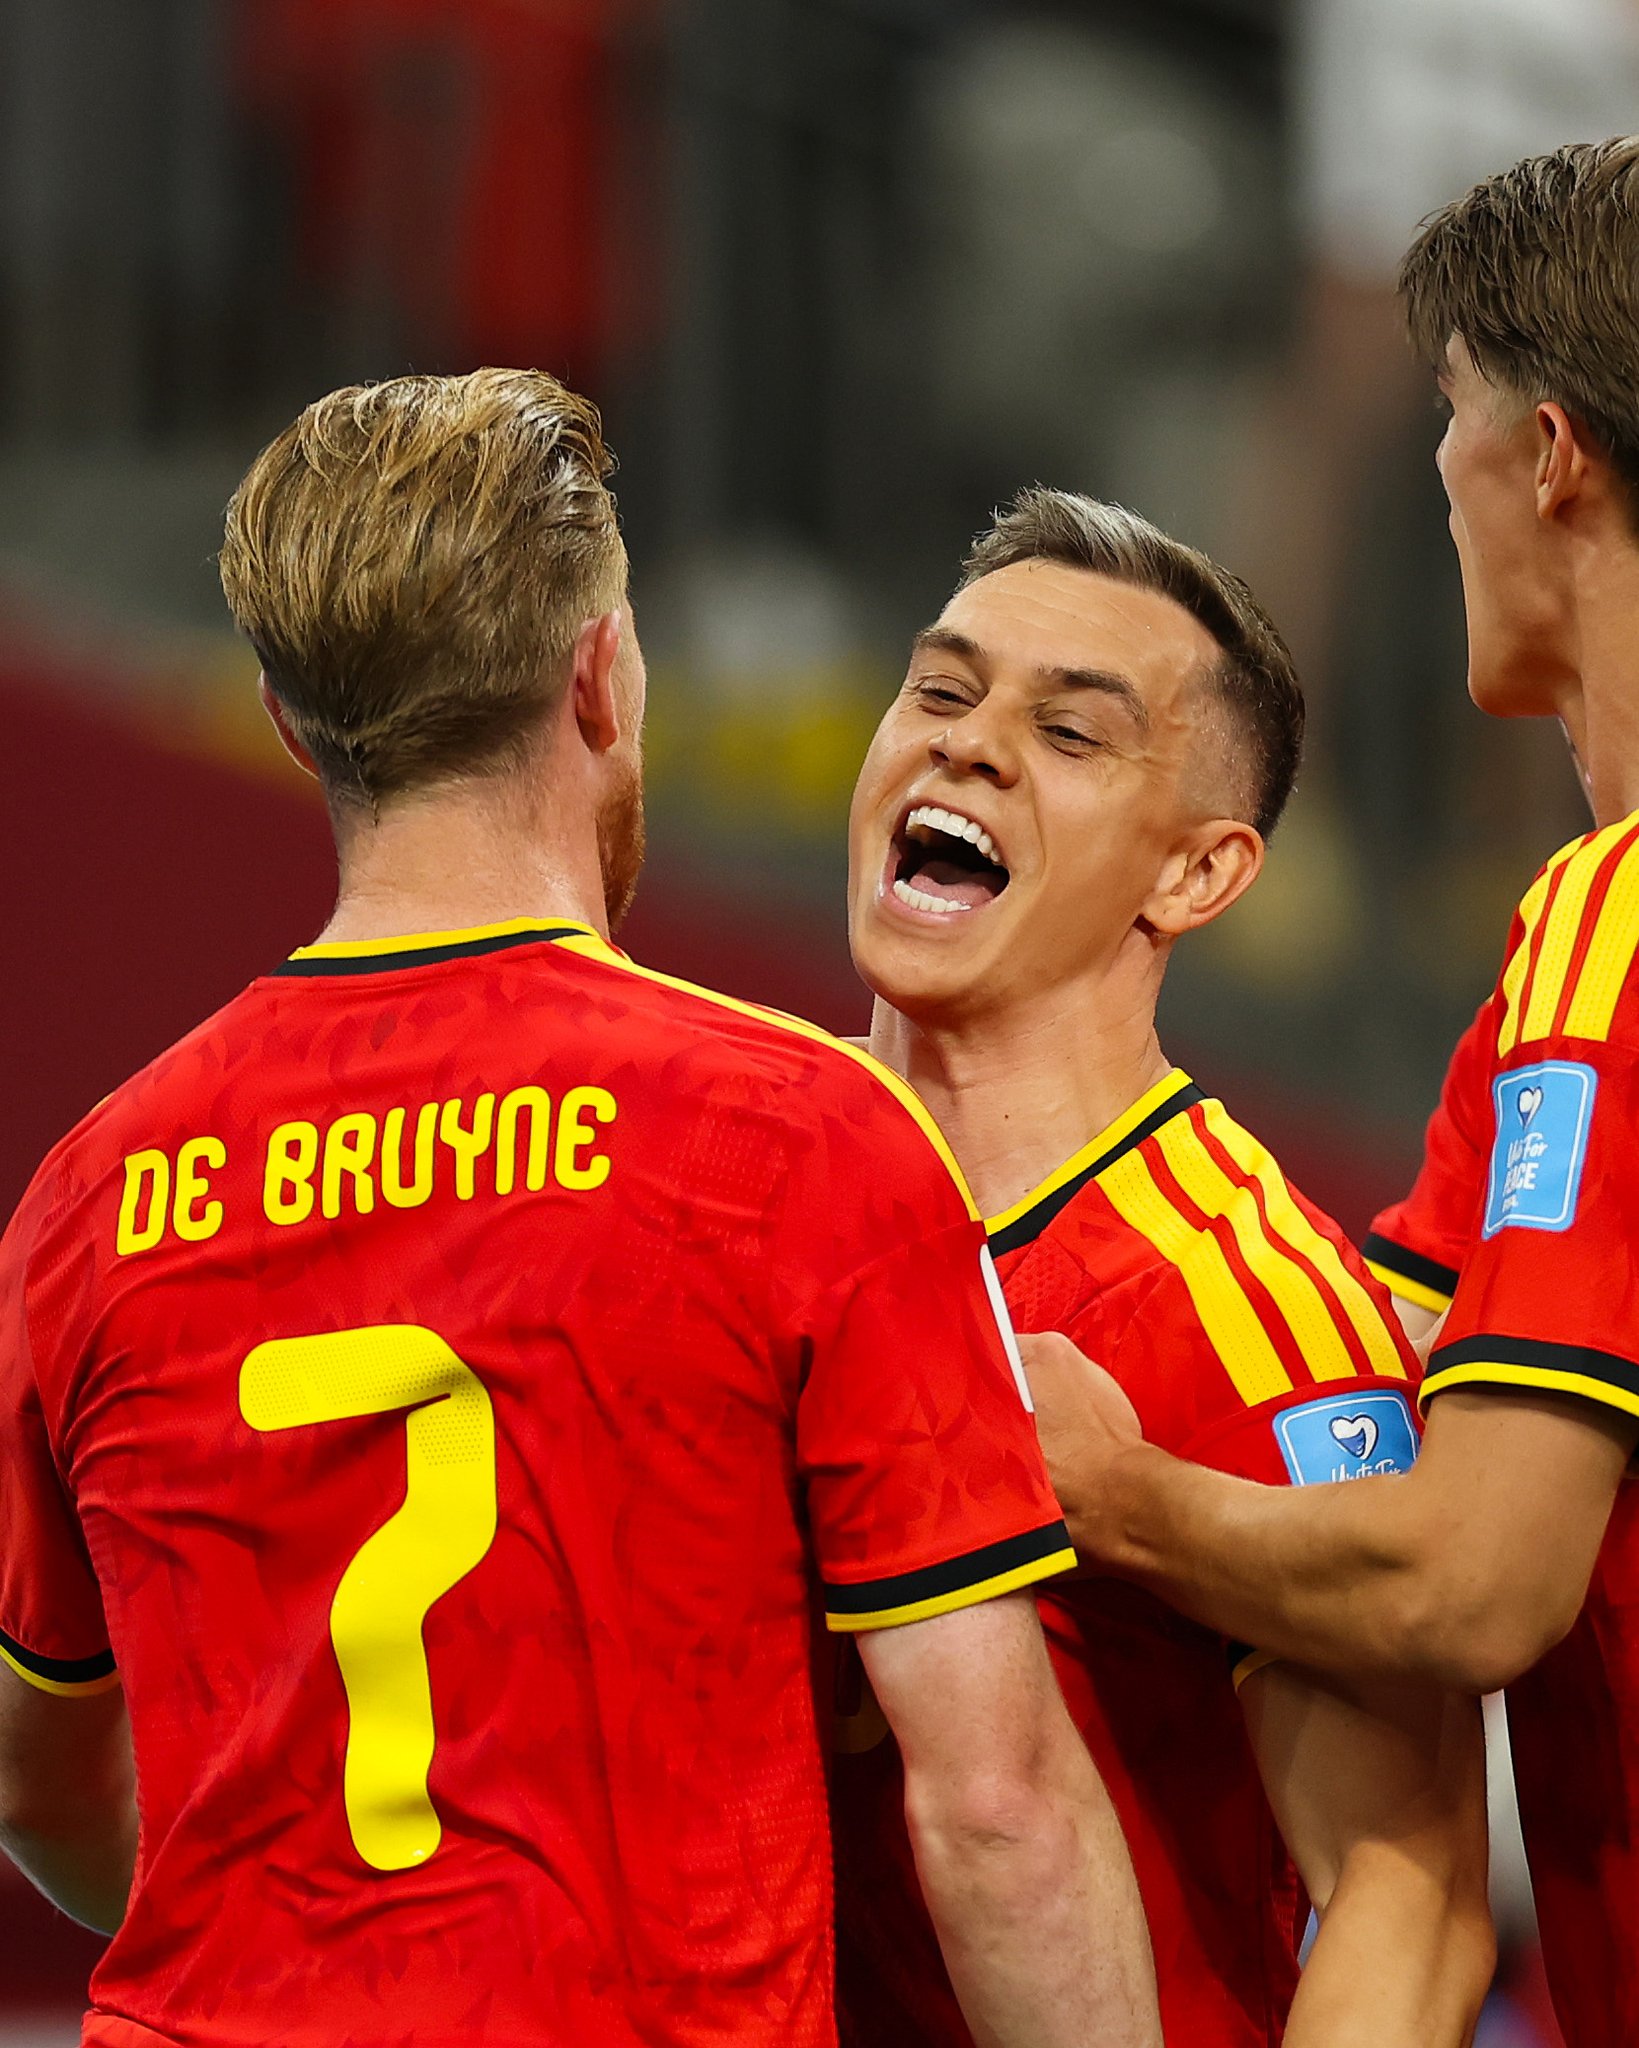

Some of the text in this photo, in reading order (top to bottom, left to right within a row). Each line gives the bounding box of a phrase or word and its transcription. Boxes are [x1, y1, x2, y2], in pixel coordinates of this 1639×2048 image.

[116, 1085, 617, 1256] DE BRUYNE
[239, 1324, 498, 1871] 7
